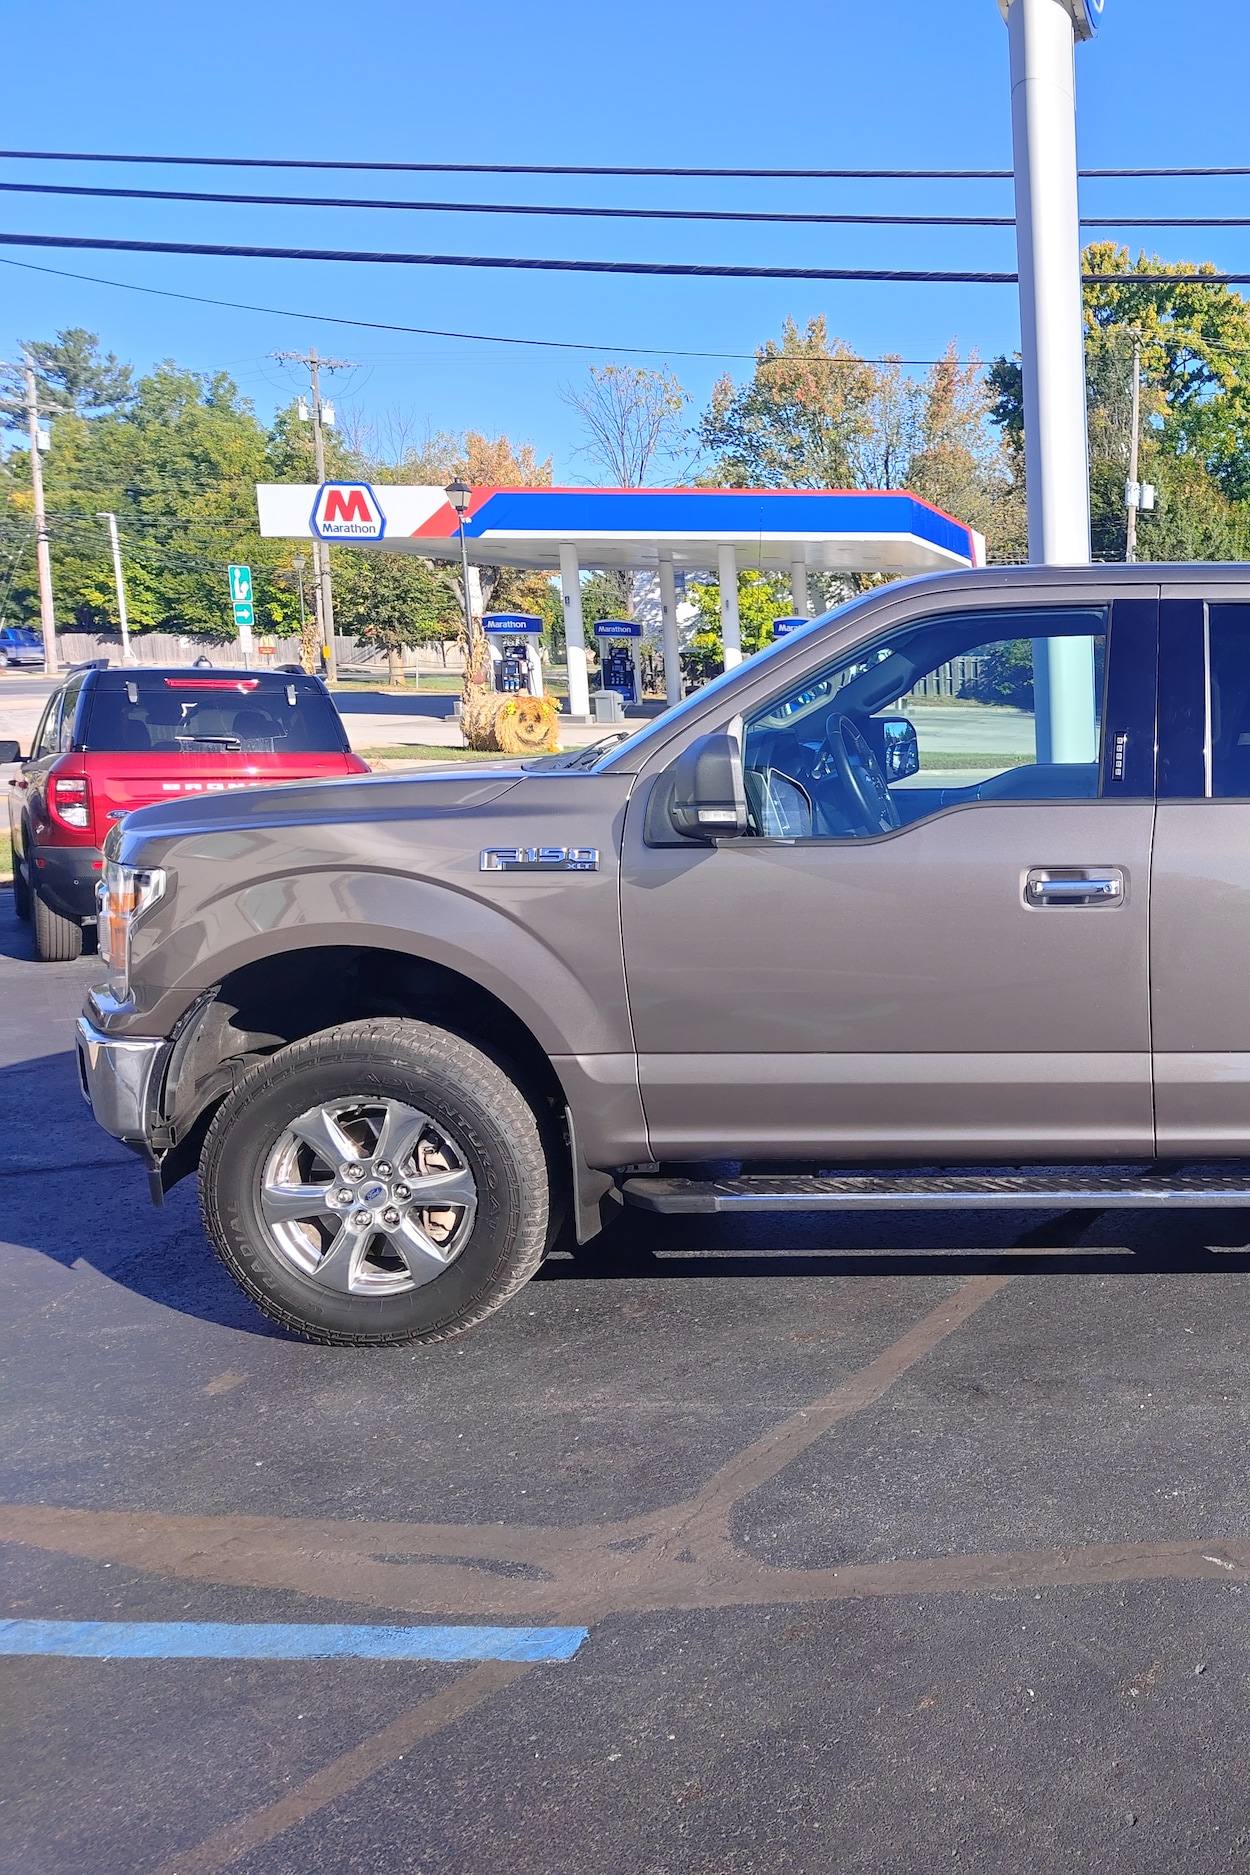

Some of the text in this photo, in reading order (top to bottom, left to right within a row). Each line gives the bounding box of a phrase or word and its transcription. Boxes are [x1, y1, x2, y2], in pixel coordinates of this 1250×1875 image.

[323, 490, 373, 522] M
[322, 523, 376, 533] Marathon
[487, 620, 527, 629] Marathon
[598, 625, 632, 633] Marathon
